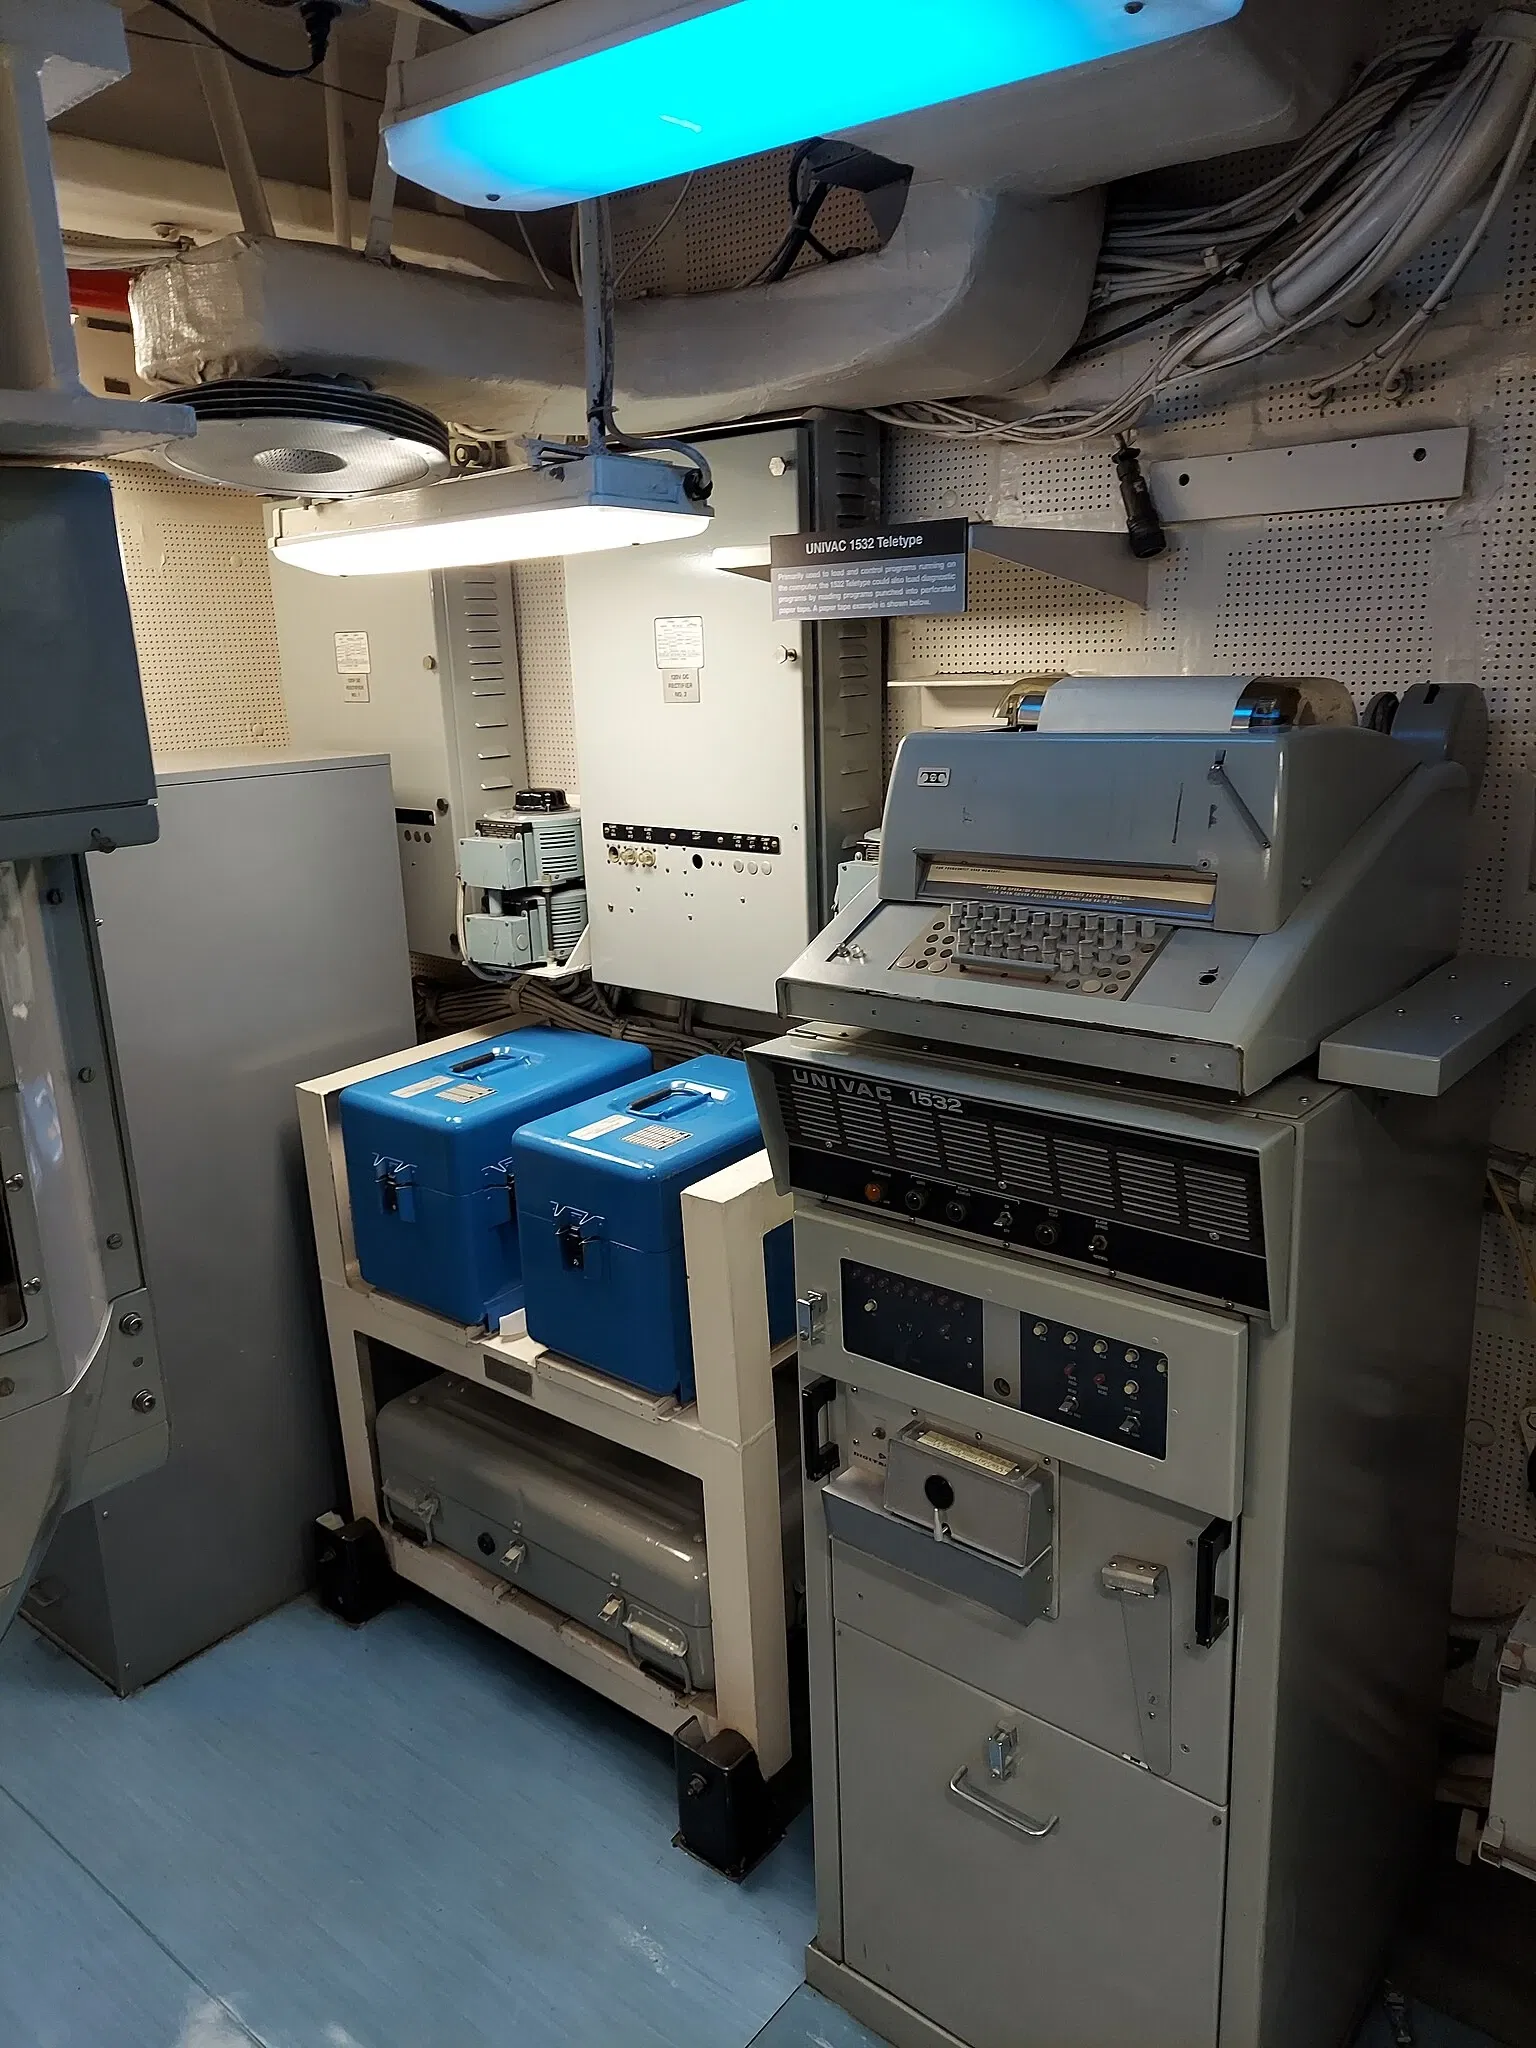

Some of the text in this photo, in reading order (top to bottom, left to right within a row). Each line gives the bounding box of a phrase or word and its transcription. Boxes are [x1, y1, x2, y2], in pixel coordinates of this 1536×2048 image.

[805, 535, 923, 555] UNIVAC 1532 Teletype
[805, 571, 821, 579] used
[830, 569, 845, 577] load
[846, 568, 859, 576] and
[860, 566, 883, 575] control
[885, 564, 917, 574] programs
[918, 562, 945, 571] running
[778, 584, 788, 592] the
[789, 583, 819, 593] computer,
[845, 579, 871, 588] Teletype
[872, 577, 890, 586] could
[890, 576, 905, 584] also
[906, 575, 920, 583] load
[921, 573, 956, 583] diagnostic
[778, 595, 807, 604] programs
[808, 593, 817, 602] by
[843, 590, 873, 600] programs
[875, 588, 904, 598] punched
[905, 587, 918, 595] into
[920, 584, 956, 595] perforated
[778, 607, 796, 615] paper
[818, 604, 837, 613] paper
[837, 603, 851, 612] tape
[852, 601, 879, 610] example
[886, 599, 908, 607] shown
[792, 1068, 964, 1114] UNIVAC 1532
